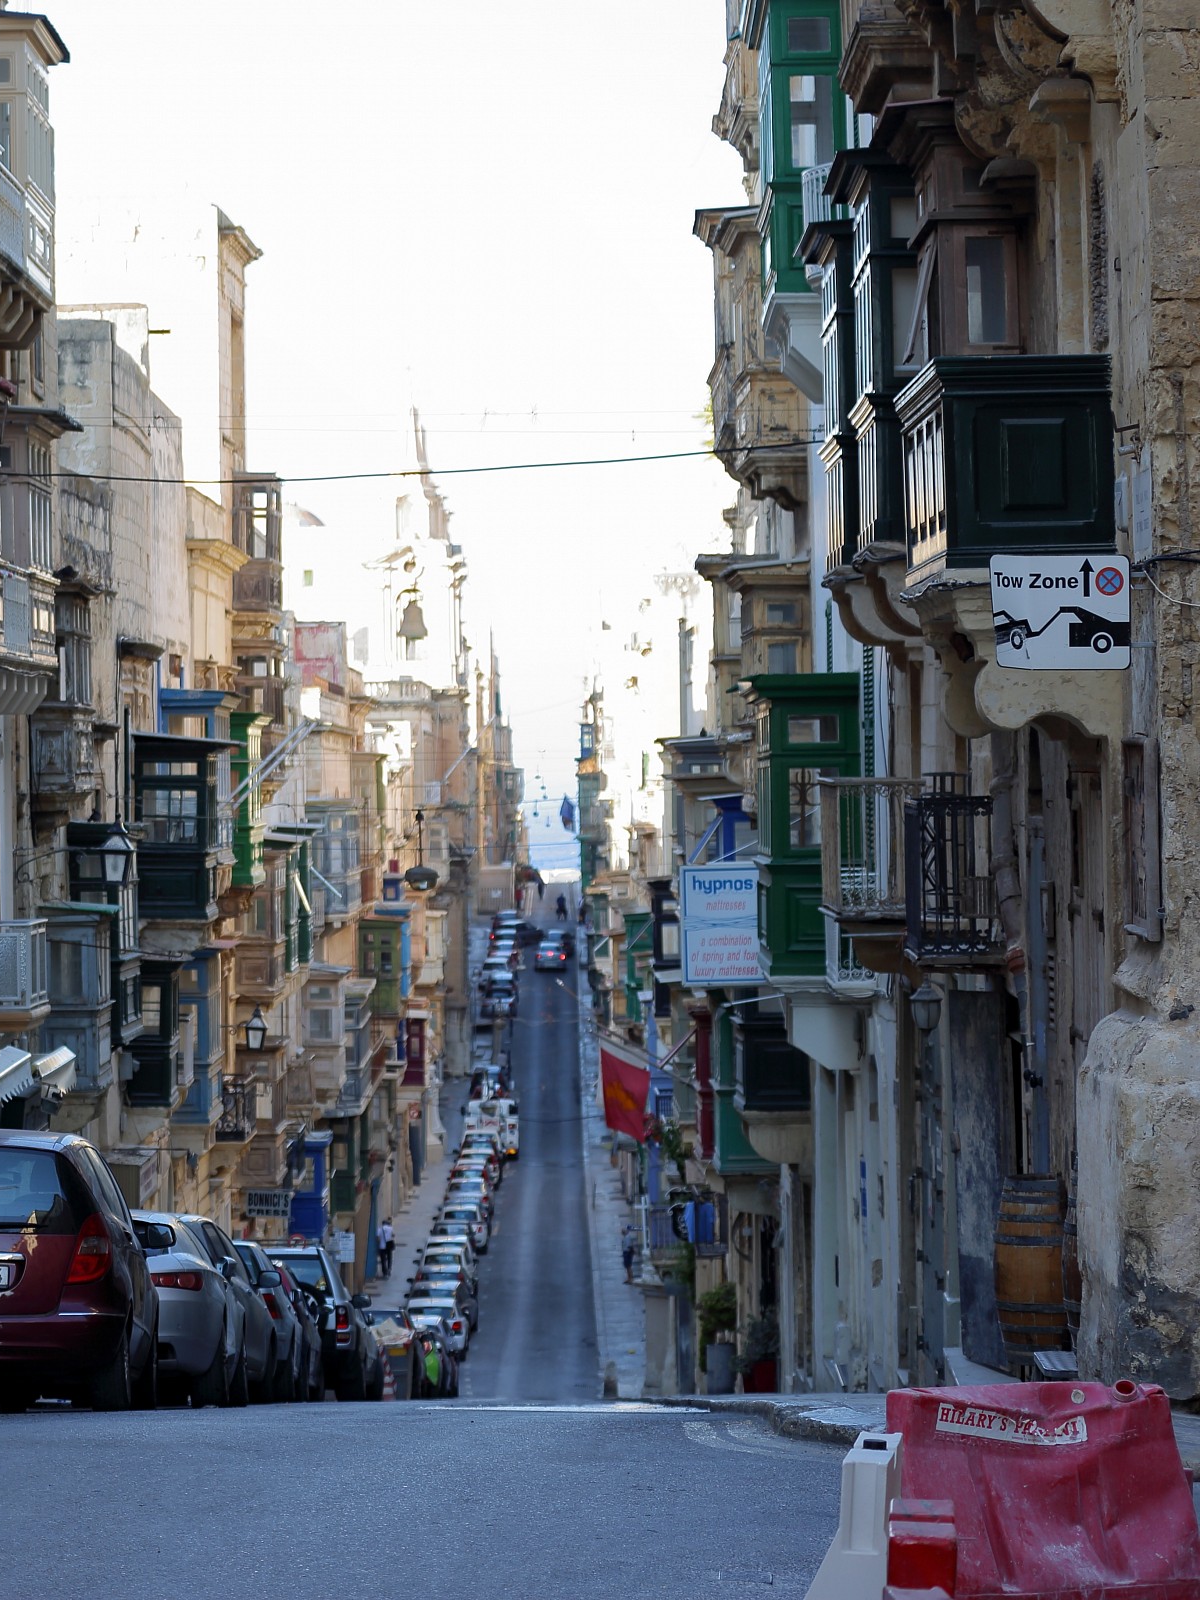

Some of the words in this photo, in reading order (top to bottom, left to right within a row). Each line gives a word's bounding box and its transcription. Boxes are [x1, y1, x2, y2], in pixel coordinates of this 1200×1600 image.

[994, 572, 1023, 588] Tow
[1029, 573, 1079, 589] Zone
[692, 875, 754, 895] hypnos
[705, 901, 747, 911] mattresses
[708, 935, 752, 946] combination
[691, 951, 699, 961] of
[702, 951, 725, 965] spring
[727, 950, 741, 961] and
[694, 965, 717, 978] luxury
[718, 965, 759, 977] mattresses
[248, 1192, 289, 1208] BONNICI'S
[248, 1209, 289, 1217] PRESS
[939, 1407, 1008, 1431] HILARY'S
